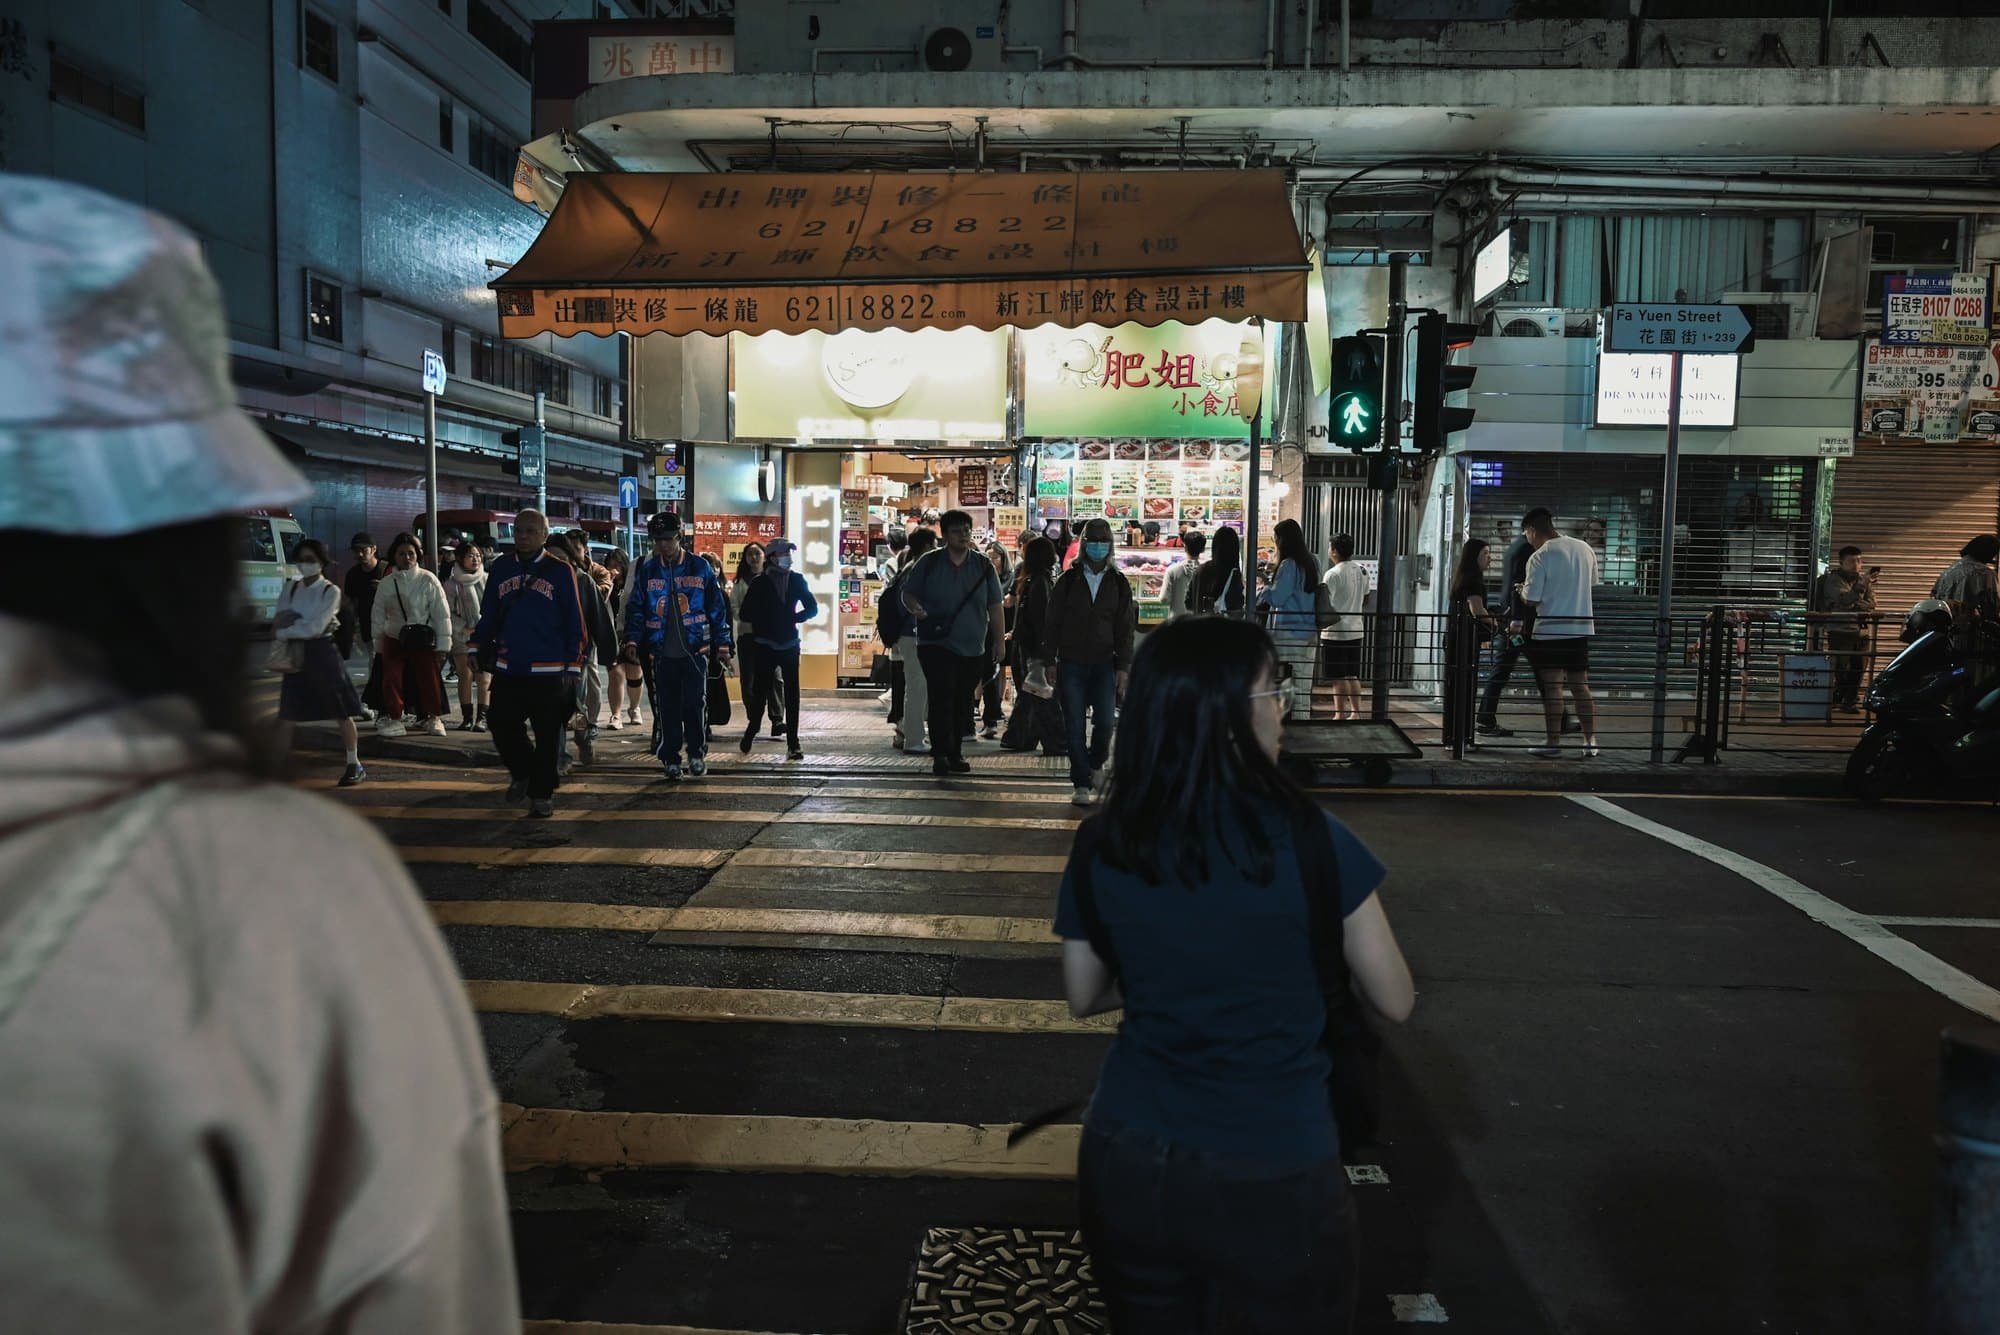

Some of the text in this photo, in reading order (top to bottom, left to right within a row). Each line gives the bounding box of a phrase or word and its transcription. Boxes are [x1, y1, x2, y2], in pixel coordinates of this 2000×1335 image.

[759, 215, 1067, 239] 62118822
[554, 297, 759, 324] 出牌裝修一條龍
[785, 294, 934, 322] 62118822
[996, 285, 1246, 317] 新江輝飲食設計樓
[1890, 297, 1982, 317] 任冠宇 8107 0268
[1616, 309, 1722, 323] Fa Yuen Street
[1639, 329, 1698, 345] 花園街
[1100, 349, 1201, 390] 肥姐
[1172, 389, 1242, 417] 小食店
[673, 575, 705, 590] YORK
